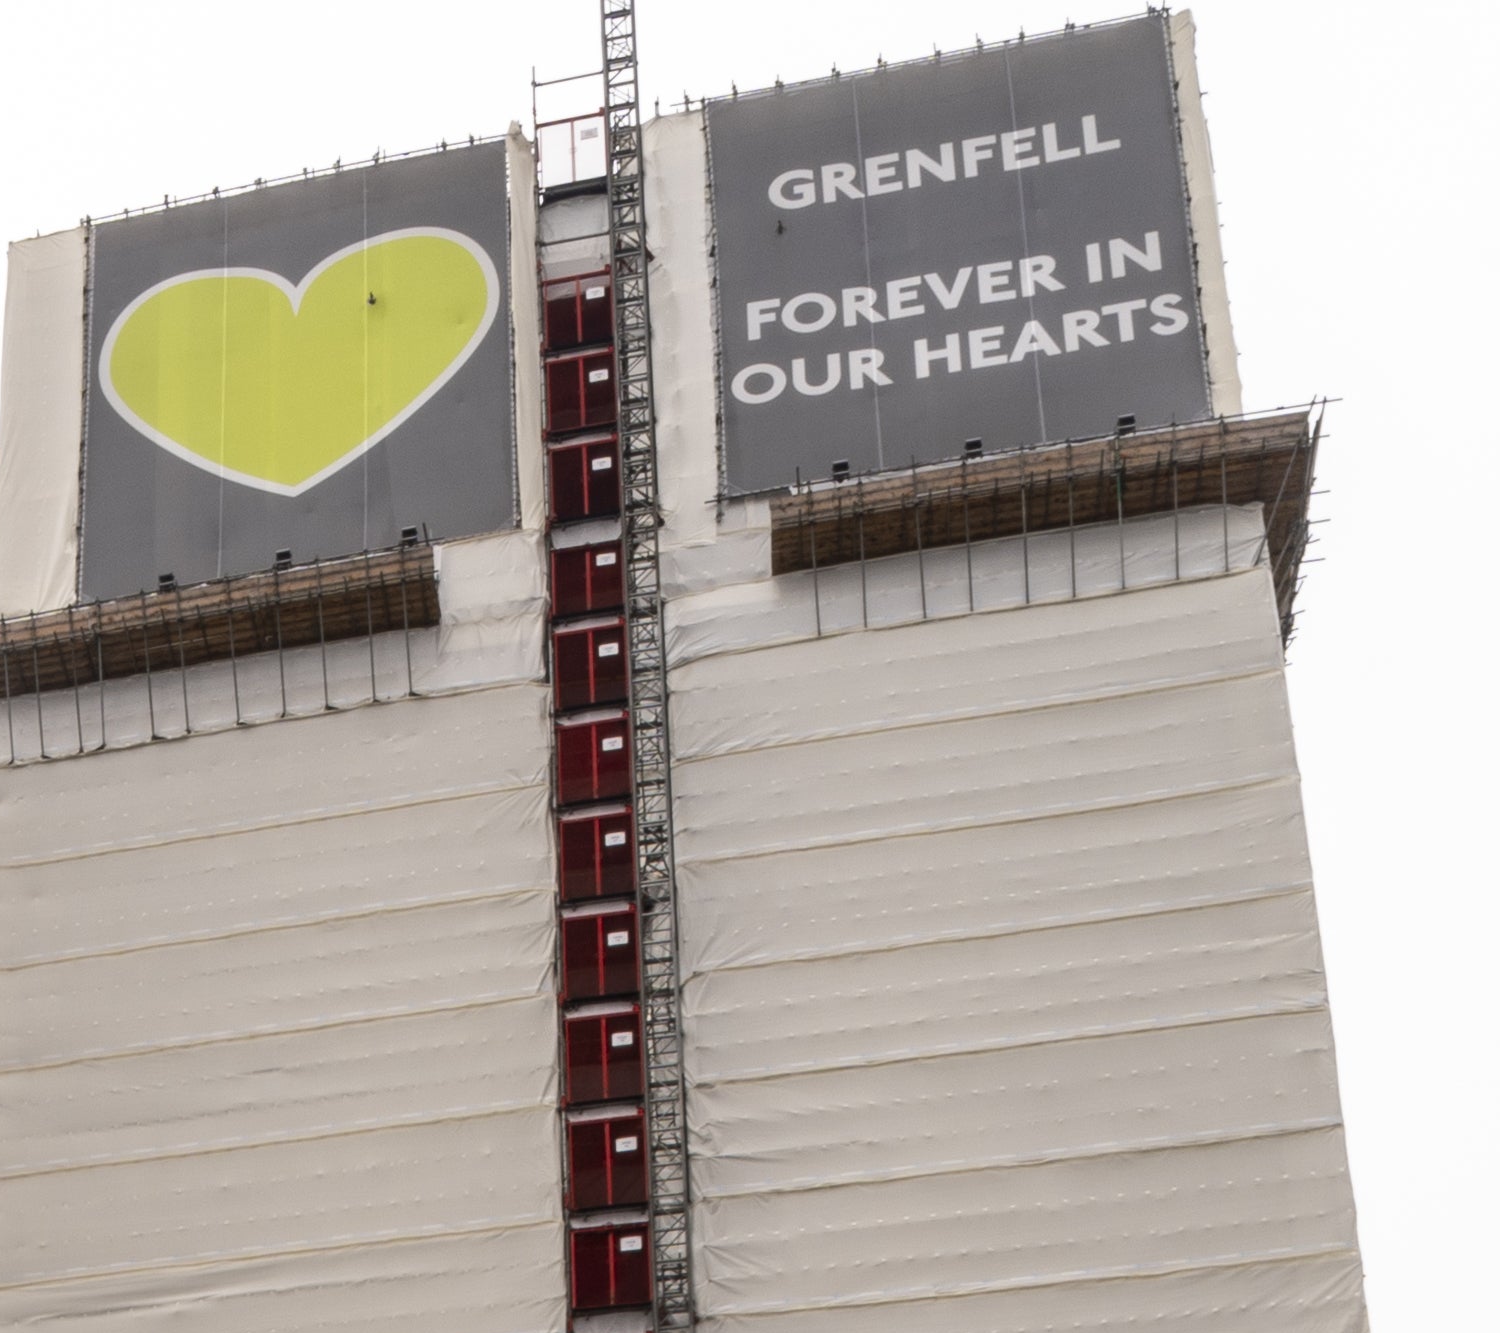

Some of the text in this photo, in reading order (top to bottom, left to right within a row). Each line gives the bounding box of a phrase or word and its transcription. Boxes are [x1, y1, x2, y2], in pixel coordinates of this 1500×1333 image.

[768, 115, 1120, 209] GRENFELL
[746, 231, 1162, 340] FOREVER IN
[731, 293, 1189, 404] OUR HEARTS
